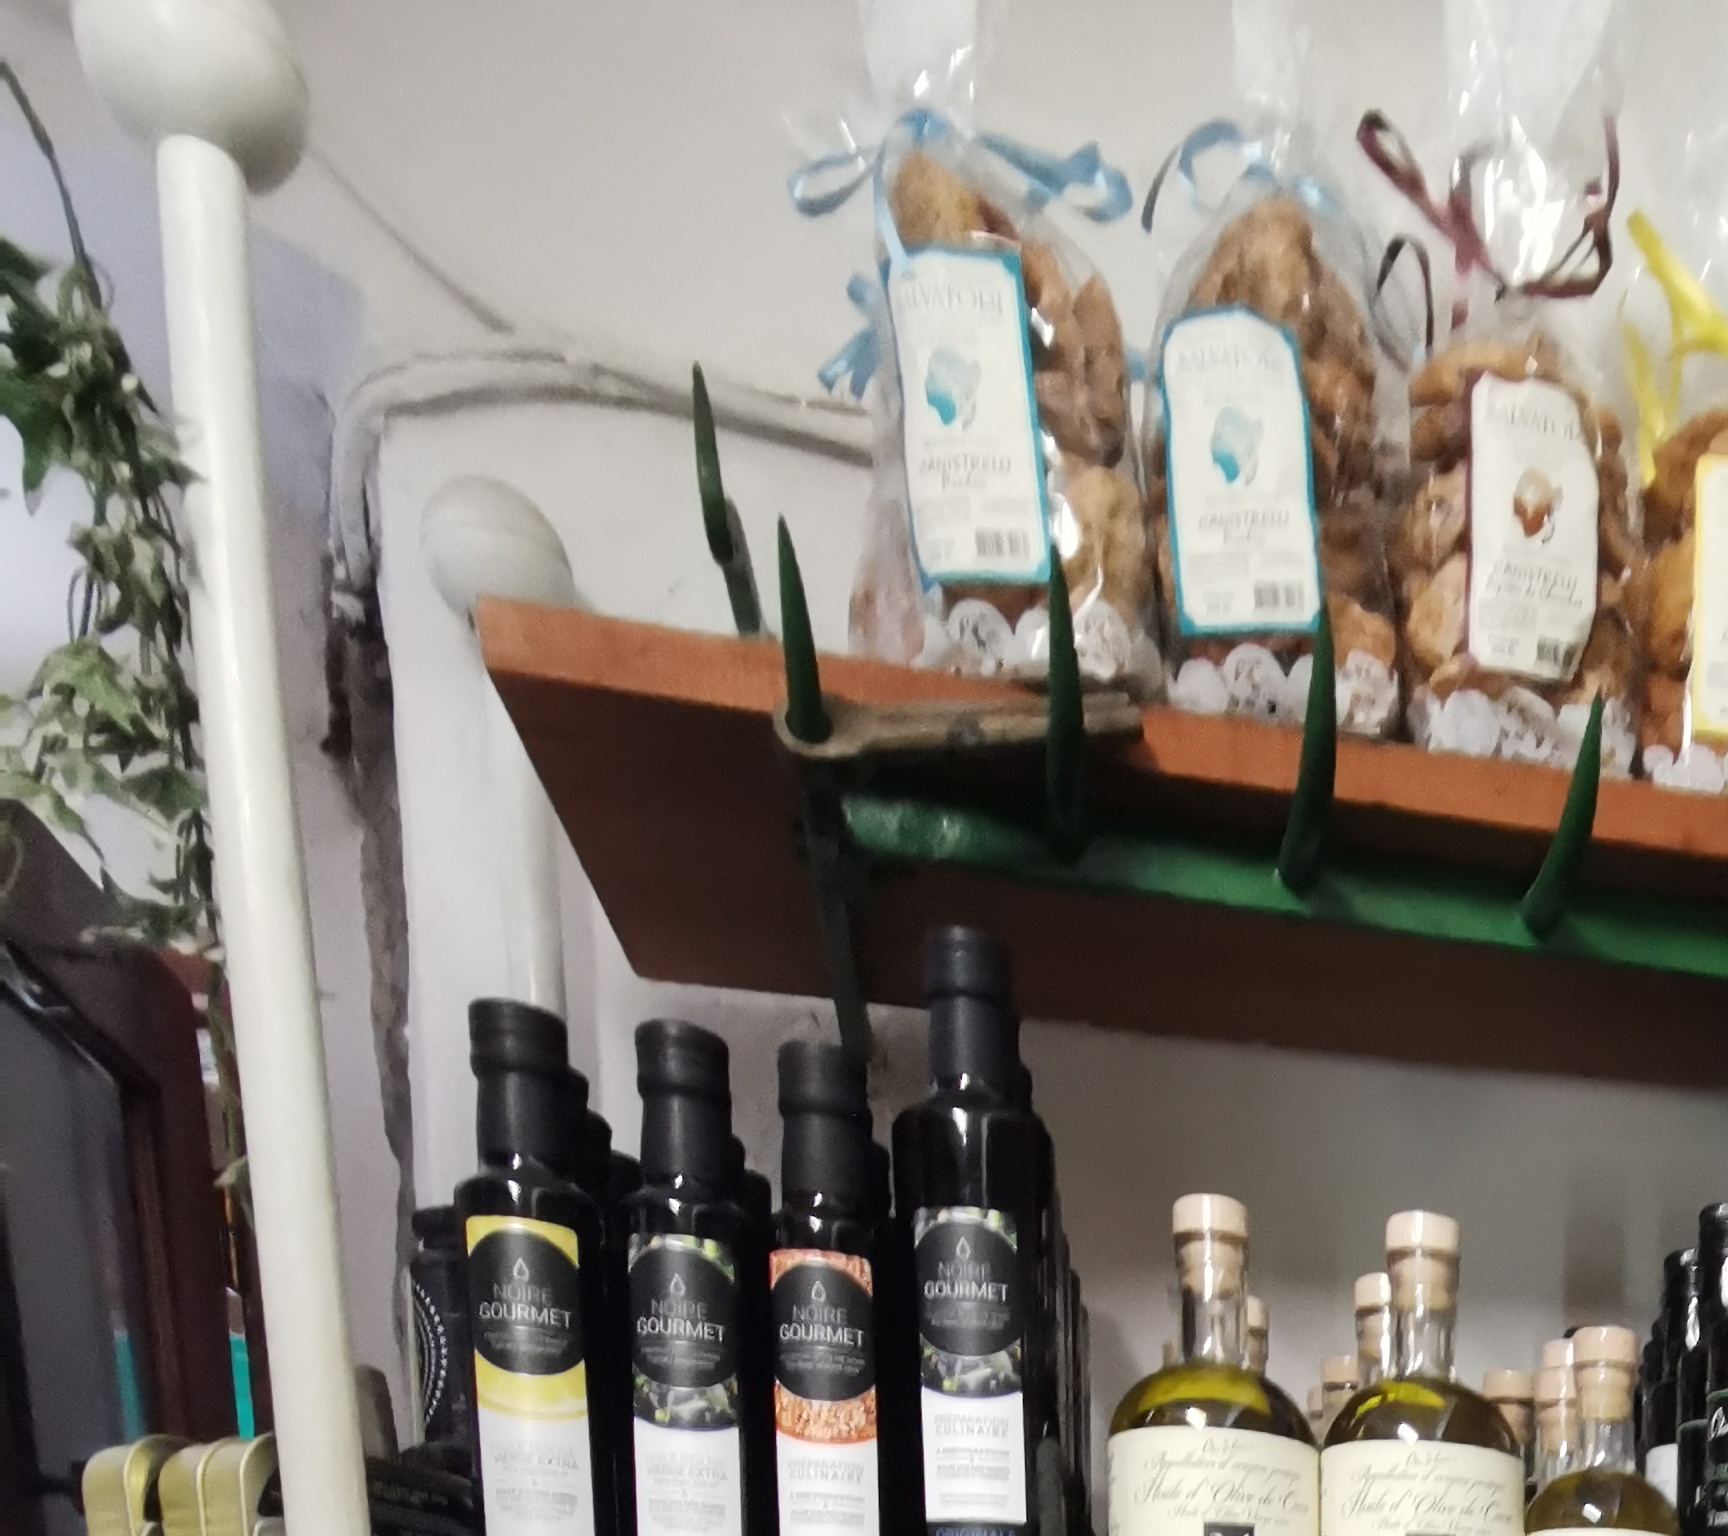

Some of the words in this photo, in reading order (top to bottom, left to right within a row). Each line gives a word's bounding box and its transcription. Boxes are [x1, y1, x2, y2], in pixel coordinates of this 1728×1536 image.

[938, 1260, 992, 1282] NOIRE
[492, 1283, 551, 1302] NOIRE
[923, 1280, 1009, 1303] GOURMET
[478, 1303, 572, 1329] GOURMET
[650, 1299, 708, 1319] NOIRE
[792, 1303, 849, 1324] NOIRE
[636, 1316, 726, 1343] GOURMET
[779, 1323, 865, 1348] GOURMET
